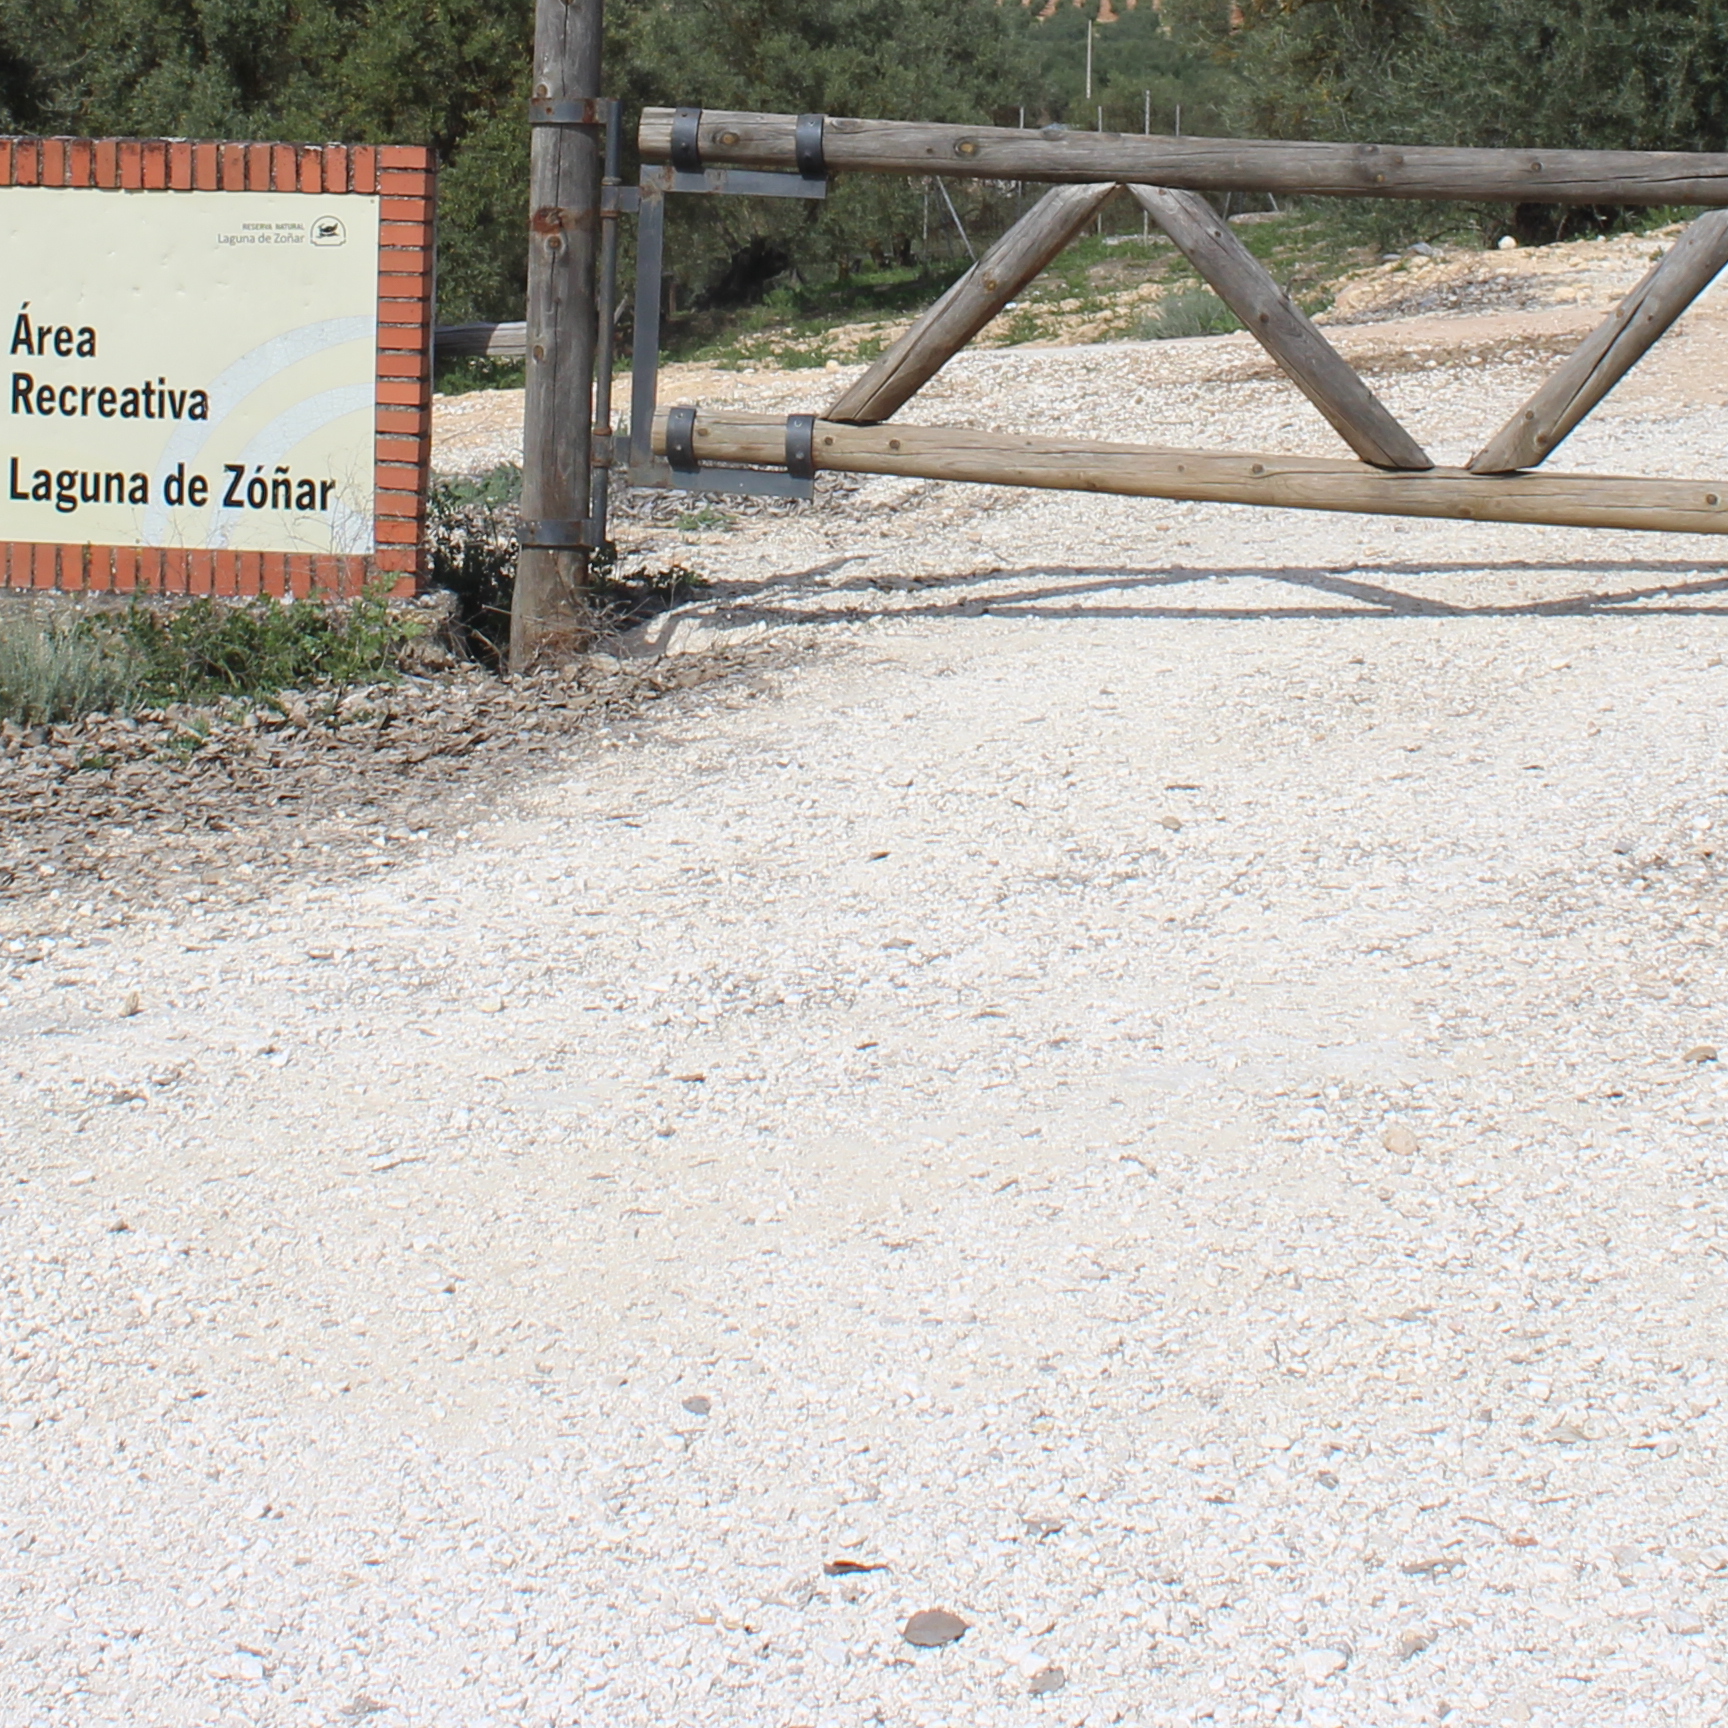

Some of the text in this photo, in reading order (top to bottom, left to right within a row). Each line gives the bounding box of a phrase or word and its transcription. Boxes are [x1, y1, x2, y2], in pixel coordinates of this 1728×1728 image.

[218, 234, 255, 246] Laguna
[258, 233, 271, 243] de
[10, 302, 95, 357] Área
[12, 372, 208, 420] Recreativa
[10, 457, 336, 513] Laguna de Zóñar
